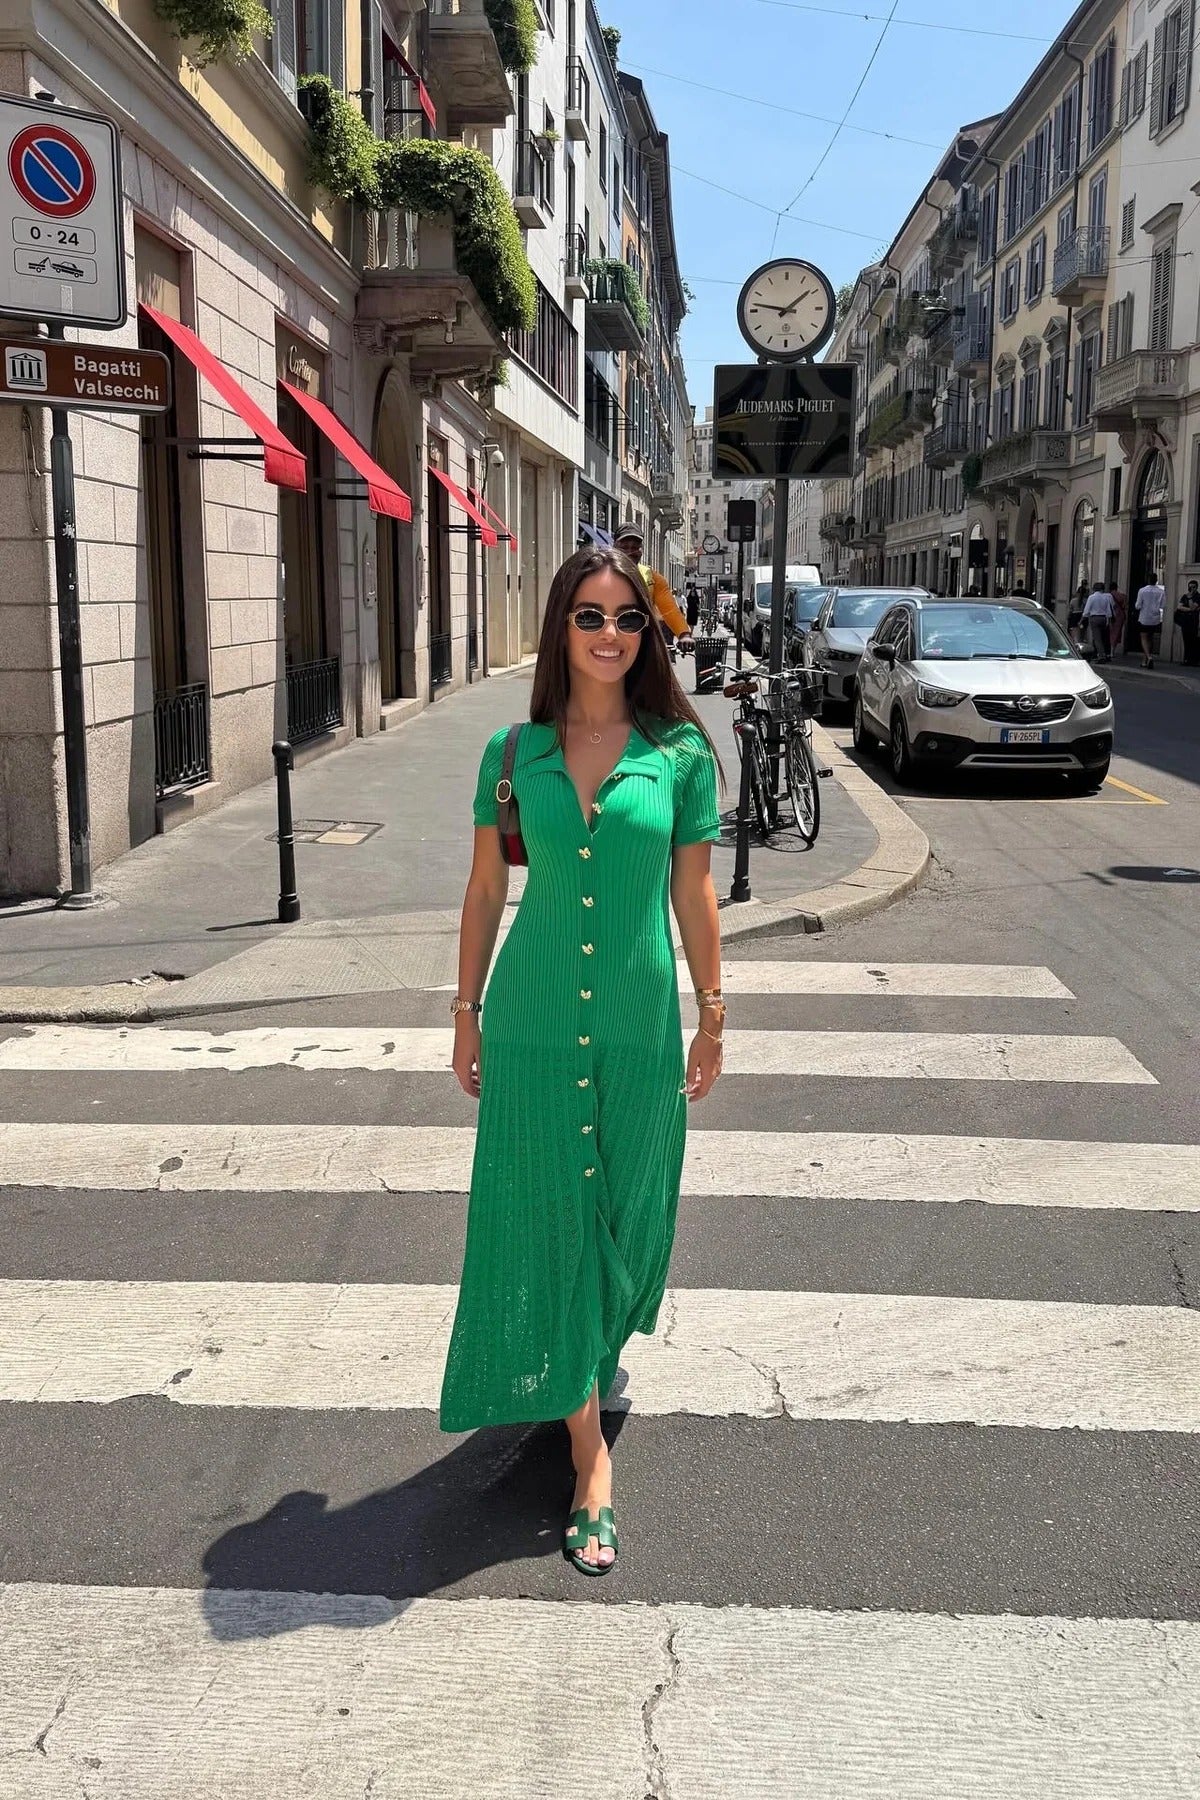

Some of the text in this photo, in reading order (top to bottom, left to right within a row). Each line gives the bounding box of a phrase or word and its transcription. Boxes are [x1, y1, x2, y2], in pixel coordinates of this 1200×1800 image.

[30, 226, 41, 240] 0
[57, 230, 80, 246] 24
[74, 355, 141, 377] Bagatti
[74, 377, 159, 401] Valsecchi
[735, 397, 836, 414] AUDEMARS PIGUET
